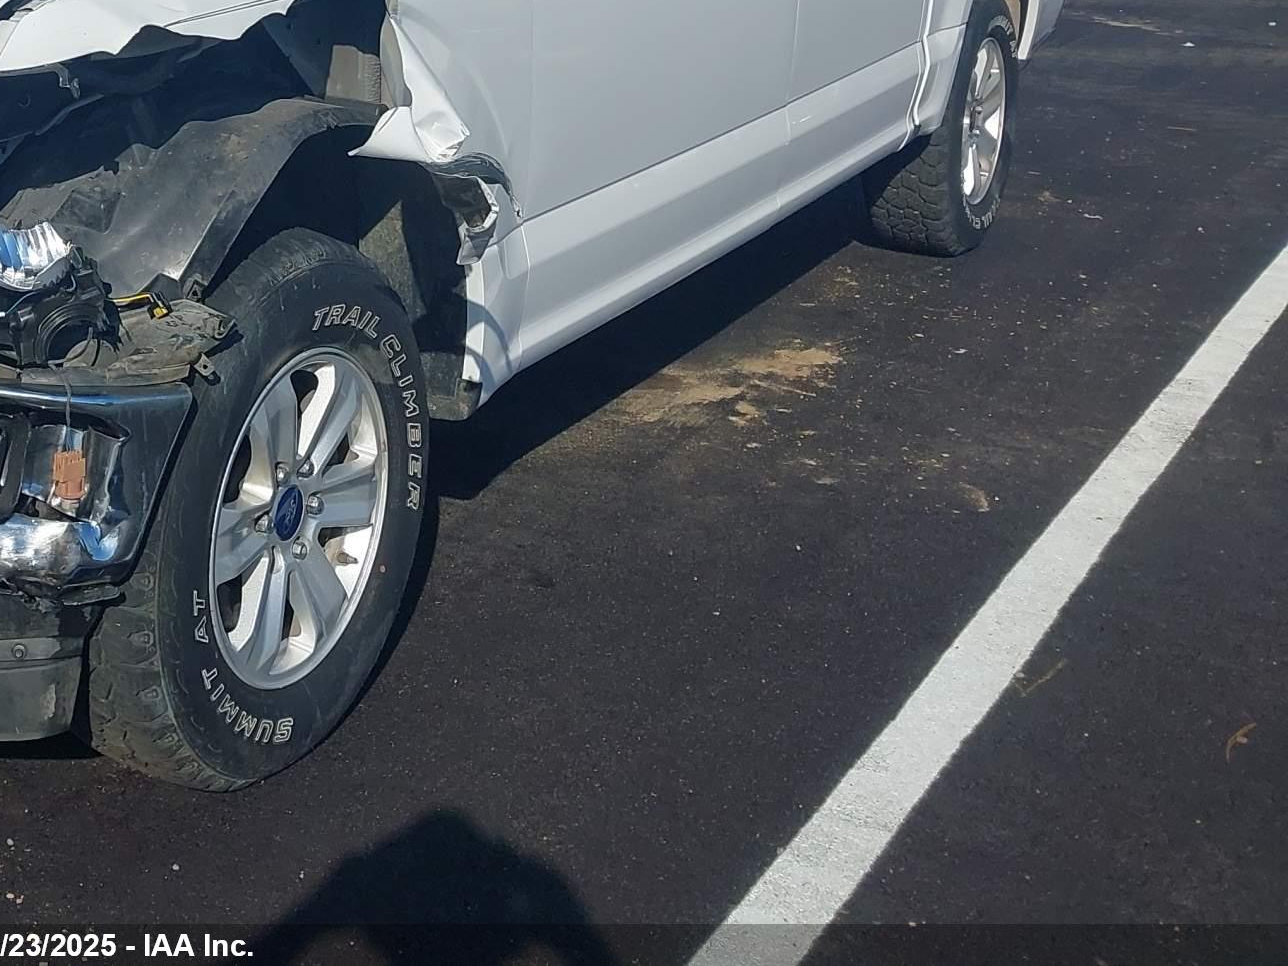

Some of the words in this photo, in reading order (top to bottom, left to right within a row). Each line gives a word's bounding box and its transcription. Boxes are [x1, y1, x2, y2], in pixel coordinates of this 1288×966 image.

[311, 303, 382, 339] TRAIL
[379, 333, 423, 511] CLIMBER
[193, 589, 209, 644] AT
[201, 667, 294, 744] SUMMIT
